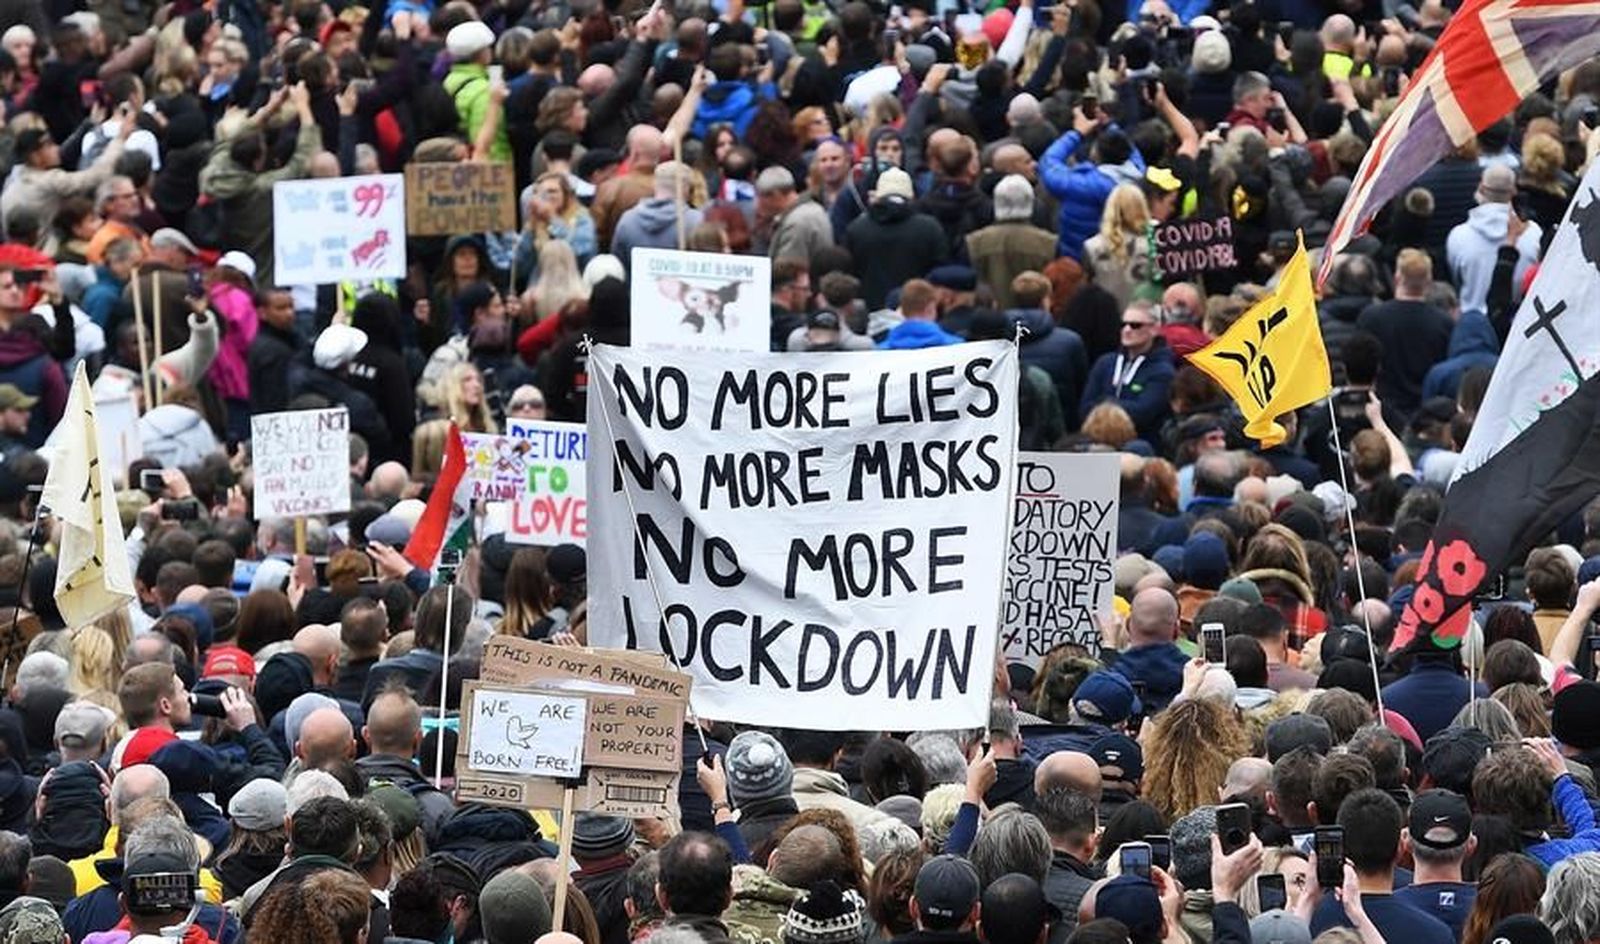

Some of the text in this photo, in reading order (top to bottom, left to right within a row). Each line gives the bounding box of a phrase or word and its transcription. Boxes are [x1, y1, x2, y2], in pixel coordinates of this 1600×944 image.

[417, 164, 505, 191] PEOPLE
[415, 207, 505, 233] POWER
[613, 357, 999, 430] NO MORE LIES
[319, 411, 347, 432] NOT
[291, 455, 315, 473] NO
[613, 434, 1001, 510] NO MORE MASKS
[529, 464, 569, 493] TO
[1017, 462, 1055, 494] TO
[513, 494, 587, 537] LOVE
[634, 513, 967, 600] NO MORE
[1036, 557, 1112, 583] TESTS
[1026, 602, 1073, 630] HAS
[1074, 606, 1094, 630] A
[493, 644, 533, 664] THIS
[558, 659, 588, 674] NOT
[590, 664, 602, 678] A
[609, 666, 684, 697] PANDEMIC
[481, 699, 576, 720] WE ARE
[592, 703, 659, 719] WE ARE
[590, 722, 677, 739] NOT YOUR
[473, 745, 578, 773] BORN FREE!
[601, 739, 675, 762] PROPERTY
[481, 784, 518, 799] 2020
